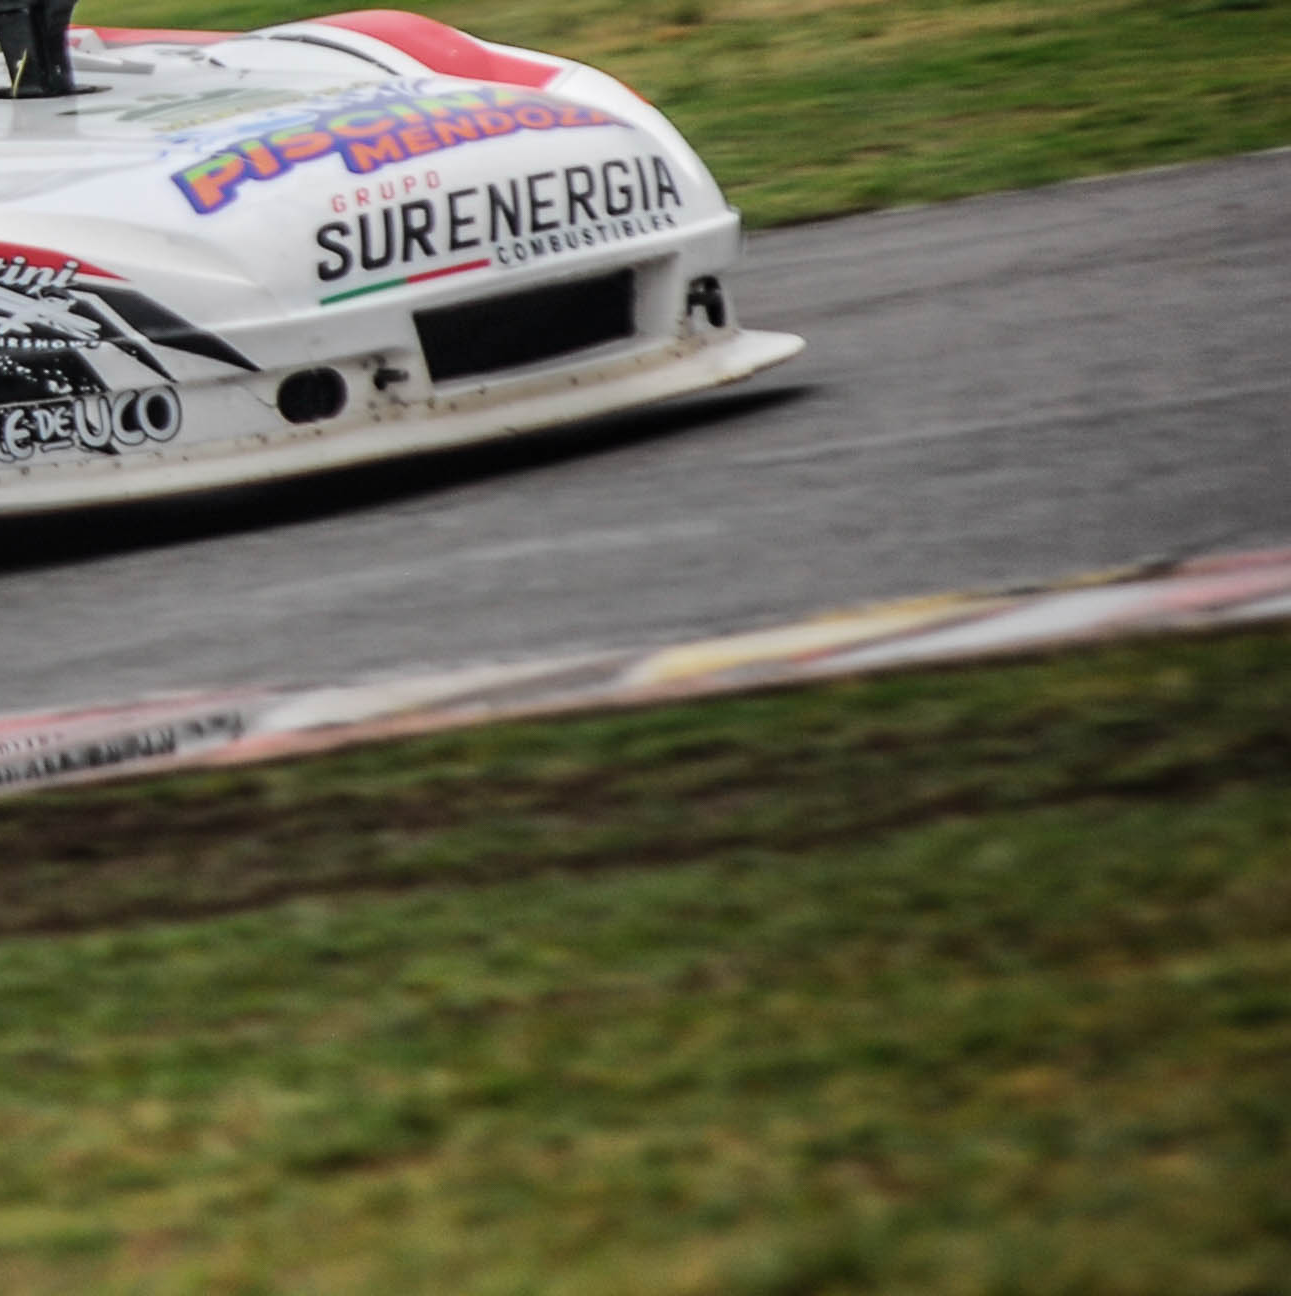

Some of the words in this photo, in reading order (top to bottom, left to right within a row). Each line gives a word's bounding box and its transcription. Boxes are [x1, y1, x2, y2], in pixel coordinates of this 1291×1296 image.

[331, 170, 441, 213] GRUPO
[317, 155, 682, 281] SURENERGIA
[496, 215, 678, 265] COMBUSTIBLES
